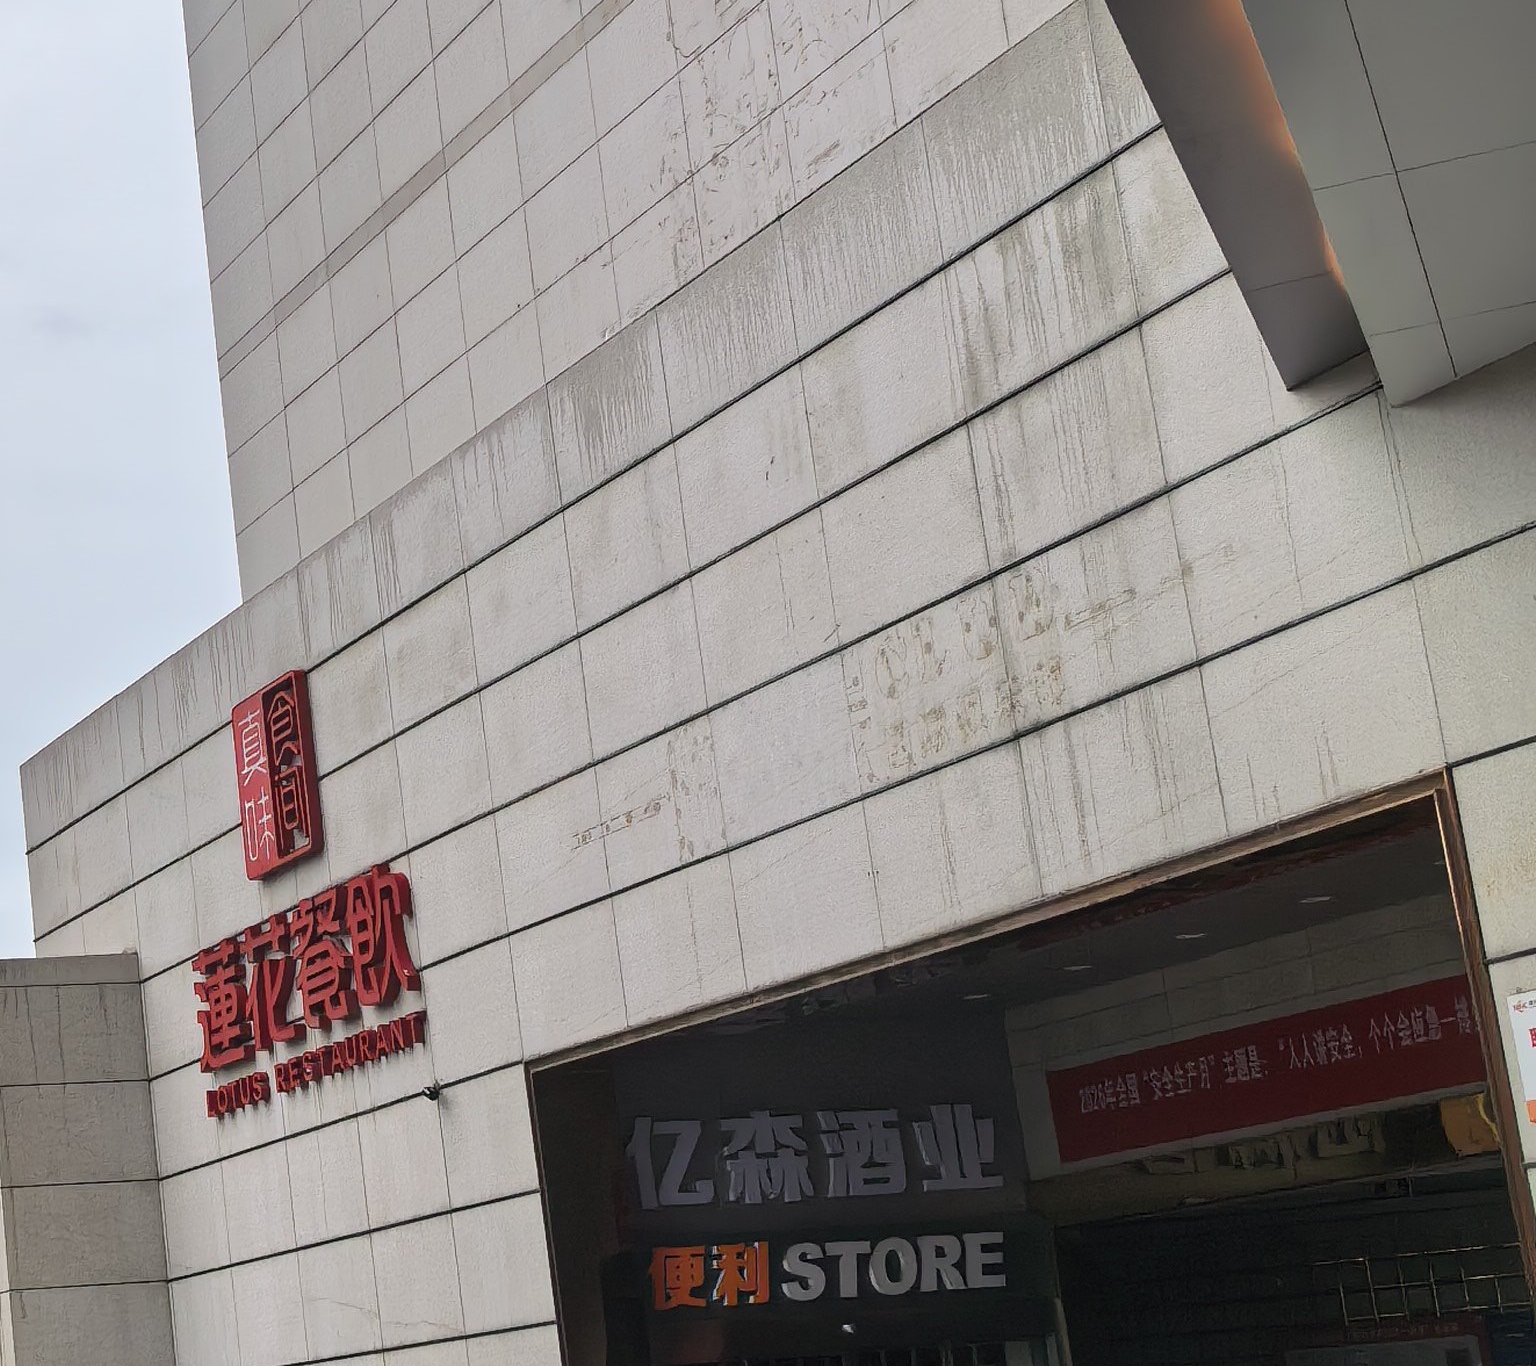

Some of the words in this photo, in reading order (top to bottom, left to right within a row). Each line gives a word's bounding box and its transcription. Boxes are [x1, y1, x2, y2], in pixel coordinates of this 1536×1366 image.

[207, 1072, 270, 1119] LOTUS
[275, 1011, 428, 1093] RESTAURANT
[625, 1104, 1005, 1210] 亿森酒业
[649, 1241, 770, 1311] 便利
[780, 1232, 1006, 1303] STORE
